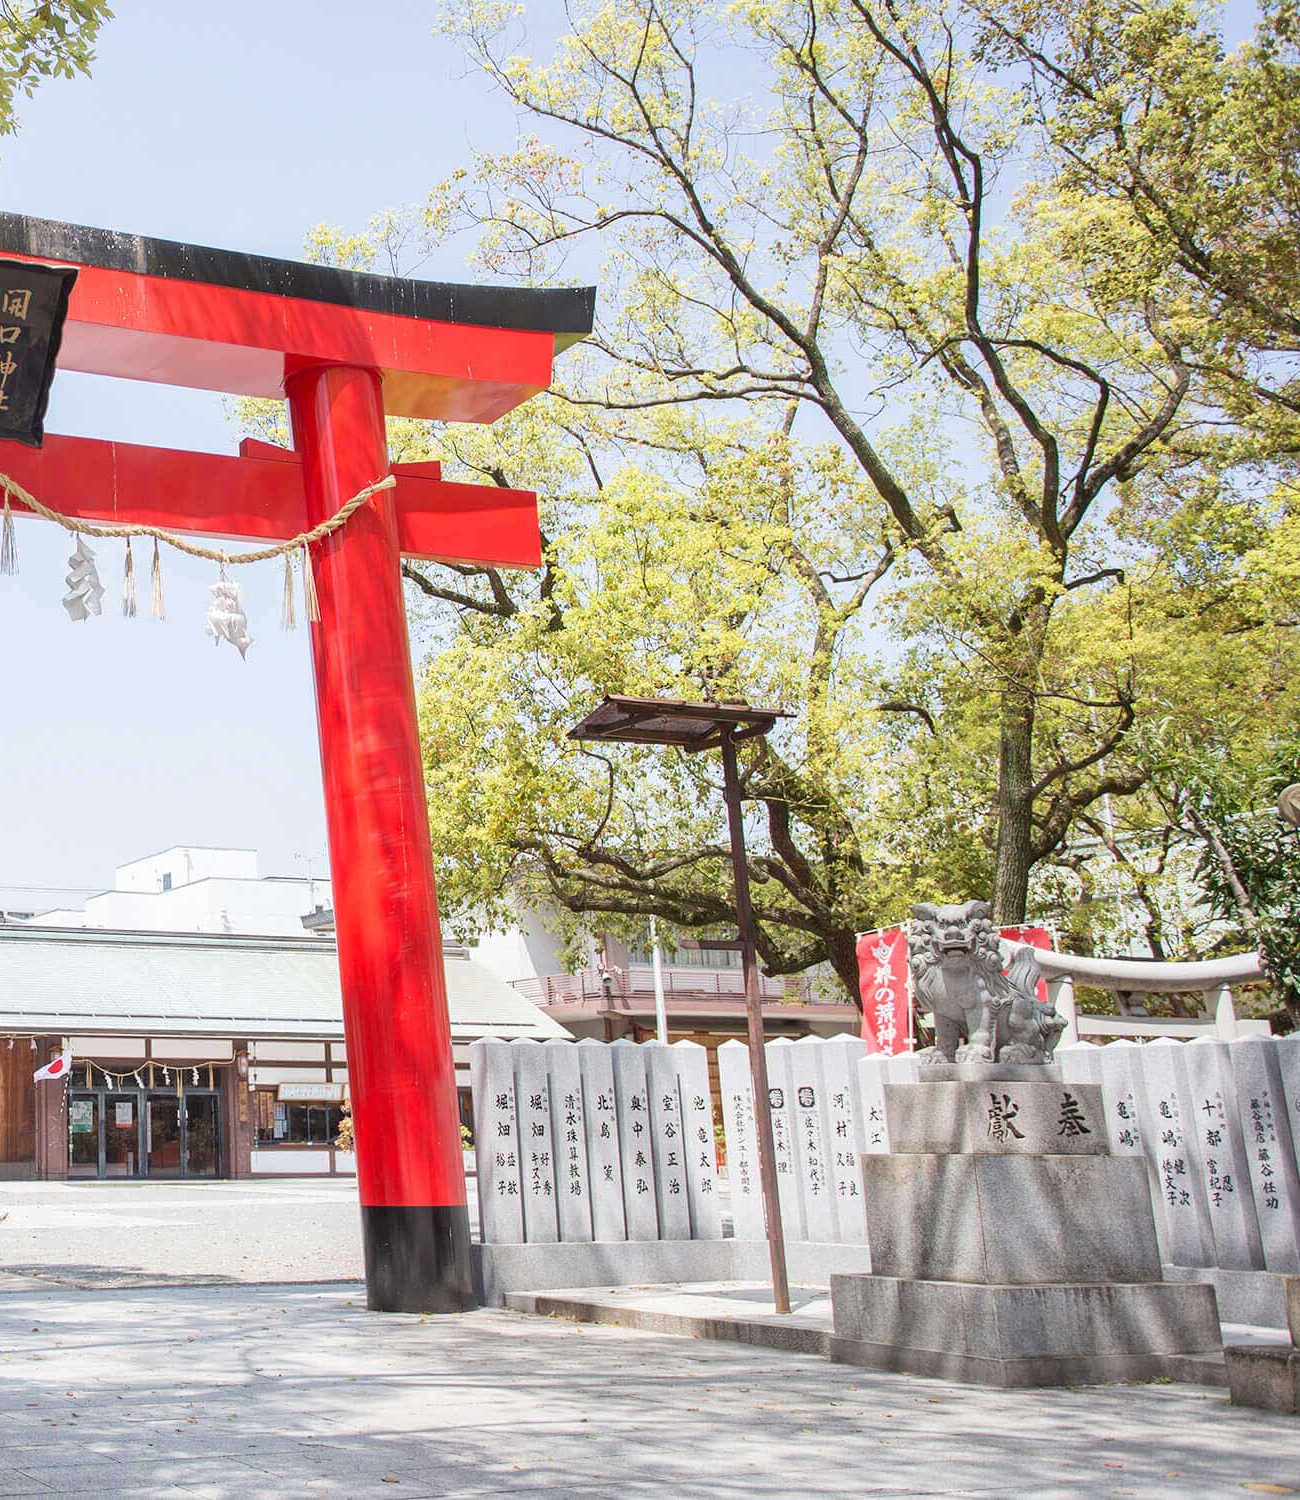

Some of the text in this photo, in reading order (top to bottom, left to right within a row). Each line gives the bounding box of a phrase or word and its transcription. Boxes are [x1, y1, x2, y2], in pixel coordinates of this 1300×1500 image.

[662, 1095, 681, 1195] 室谷正治
[833, 1093, 847, 1138] 河村
